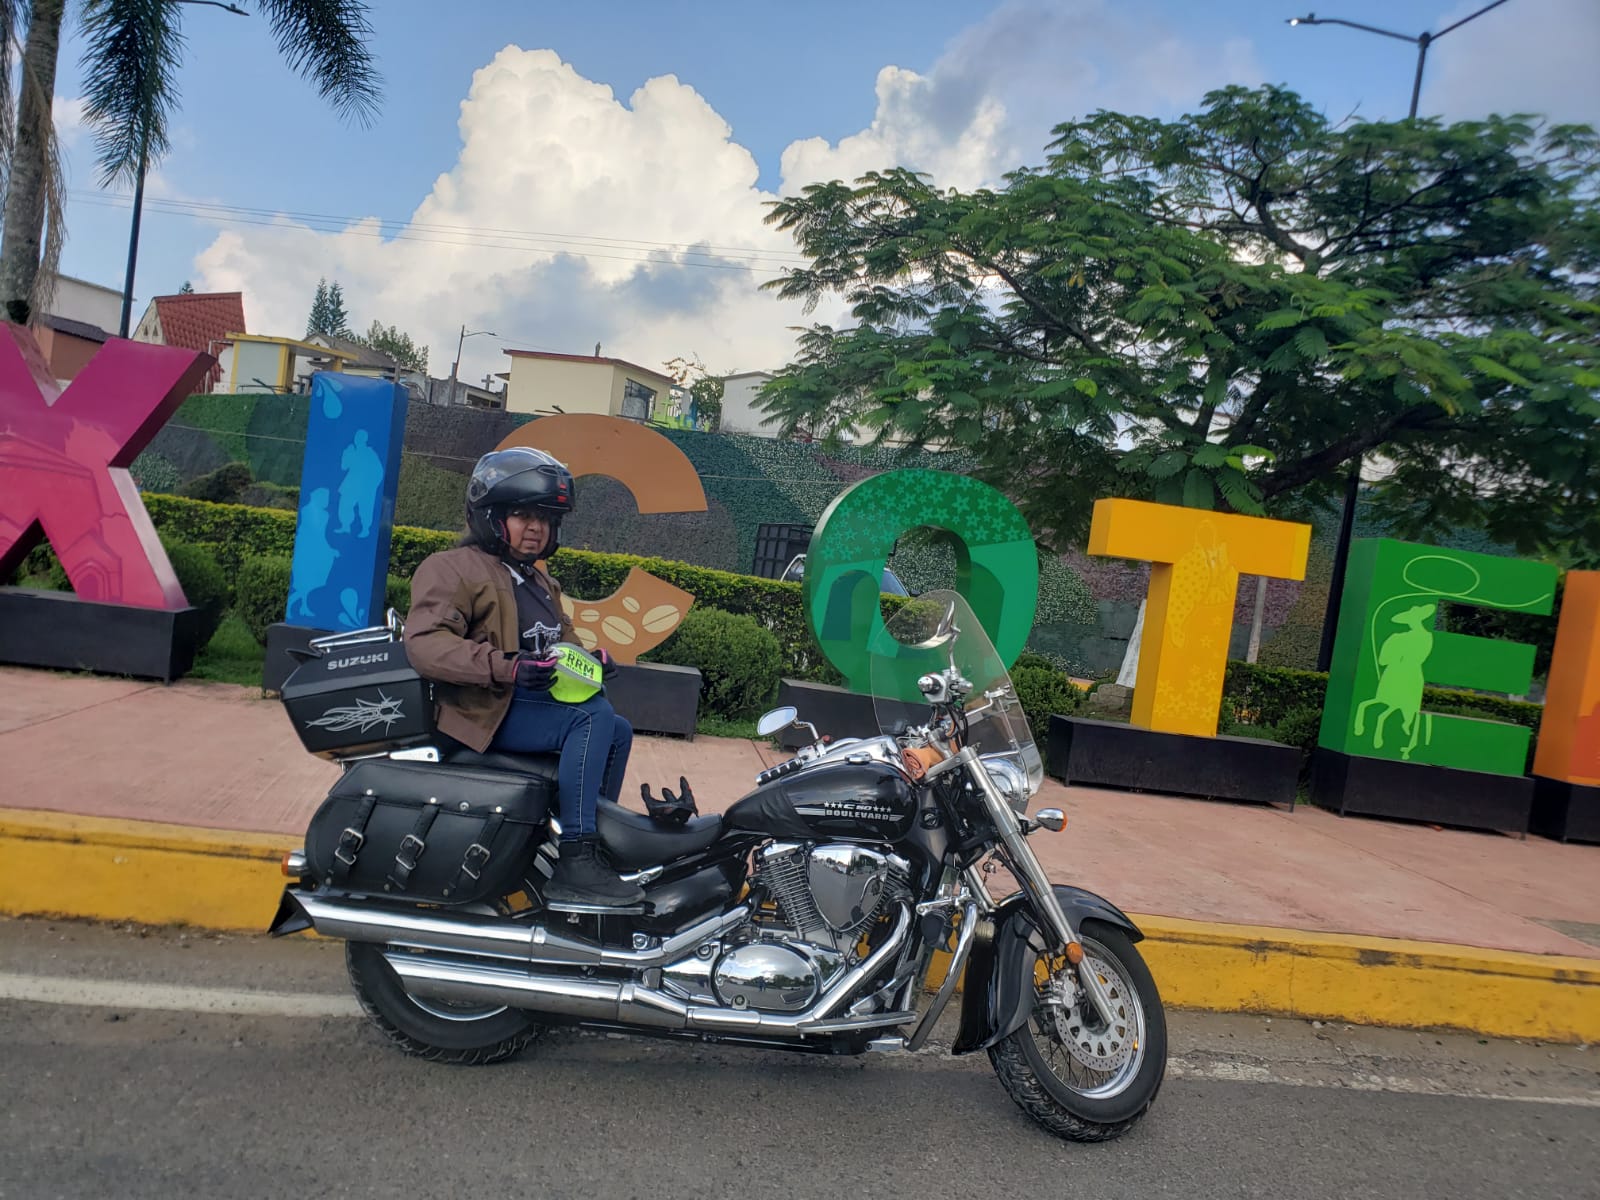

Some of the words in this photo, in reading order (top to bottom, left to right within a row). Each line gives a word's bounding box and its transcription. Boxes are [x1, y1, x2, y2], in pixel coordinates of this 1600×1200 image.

[327, 652, 389, 670] SUZUKI
[567, 653, 595, 676] RRM
[826, 809, 889, 820] BOULEVARD
